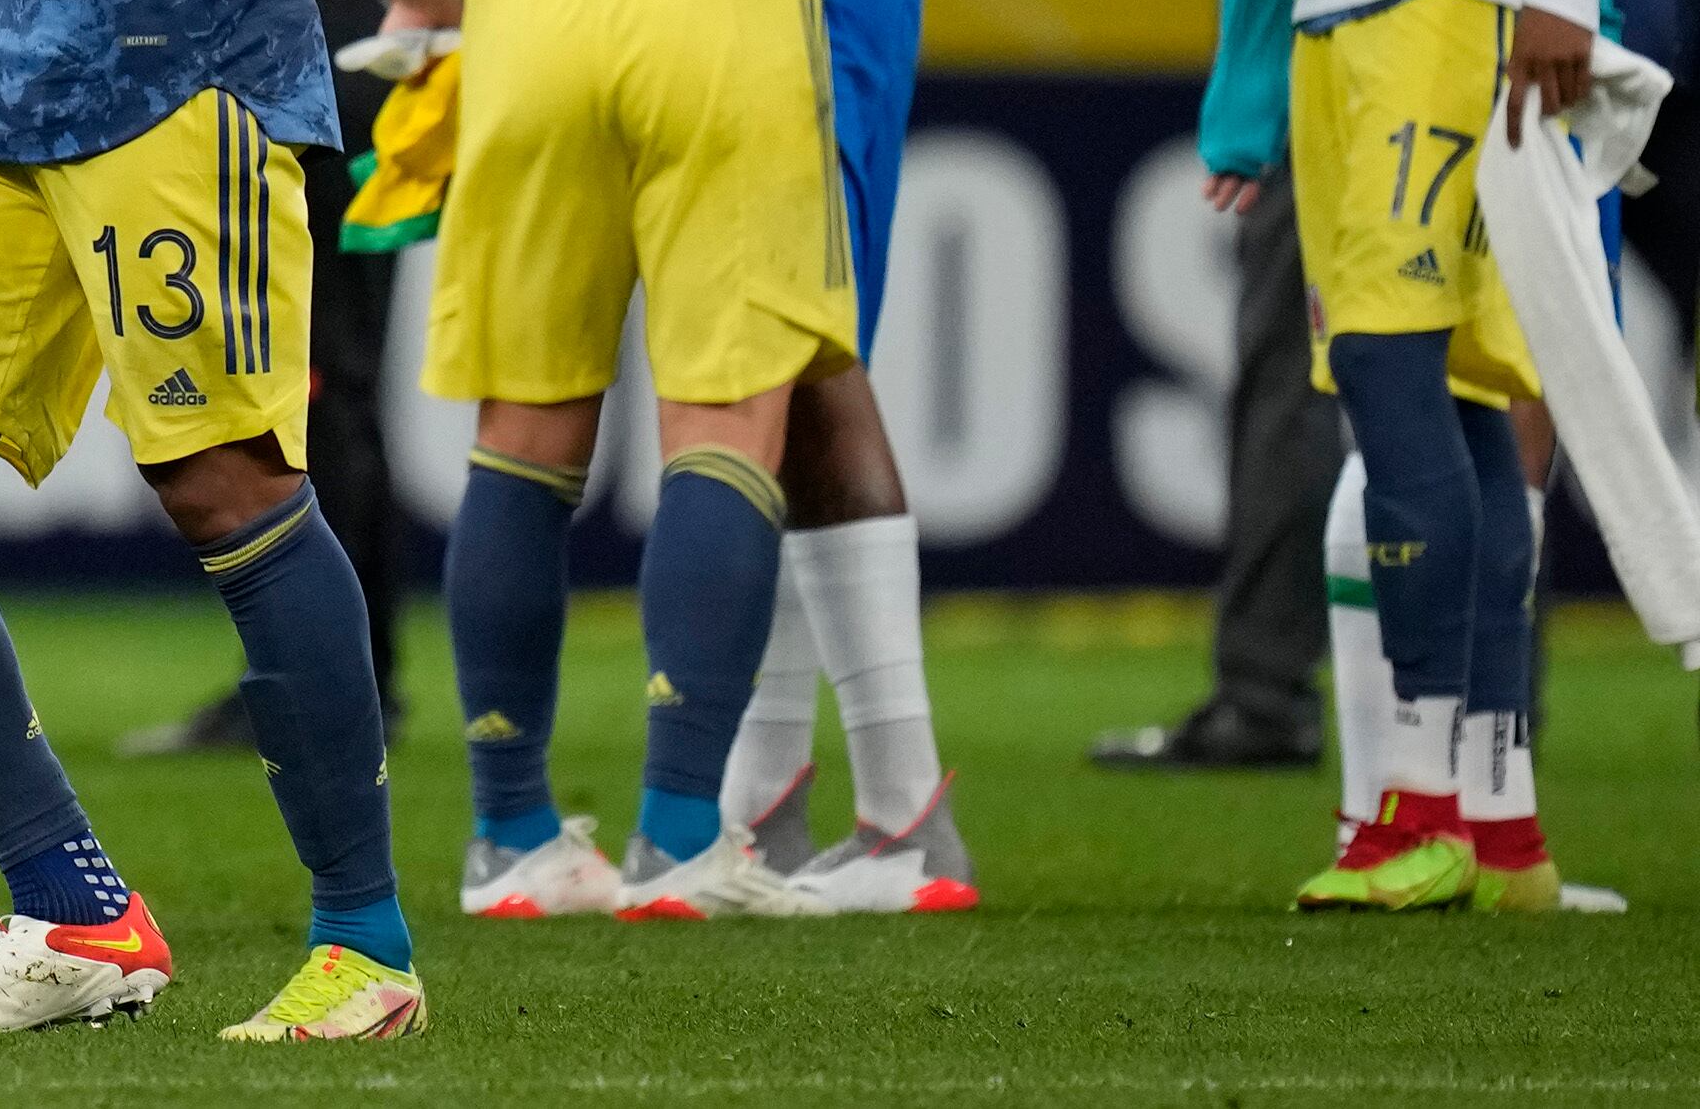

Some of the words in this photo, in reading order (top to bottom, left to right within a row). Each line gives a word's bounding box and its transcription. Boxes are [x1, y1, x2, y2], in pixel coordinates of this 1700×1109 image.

[1388, 120, 1476, 226] 17
[92, 224, 205, 340] 13
[148, 392, 207, 406] adidas
